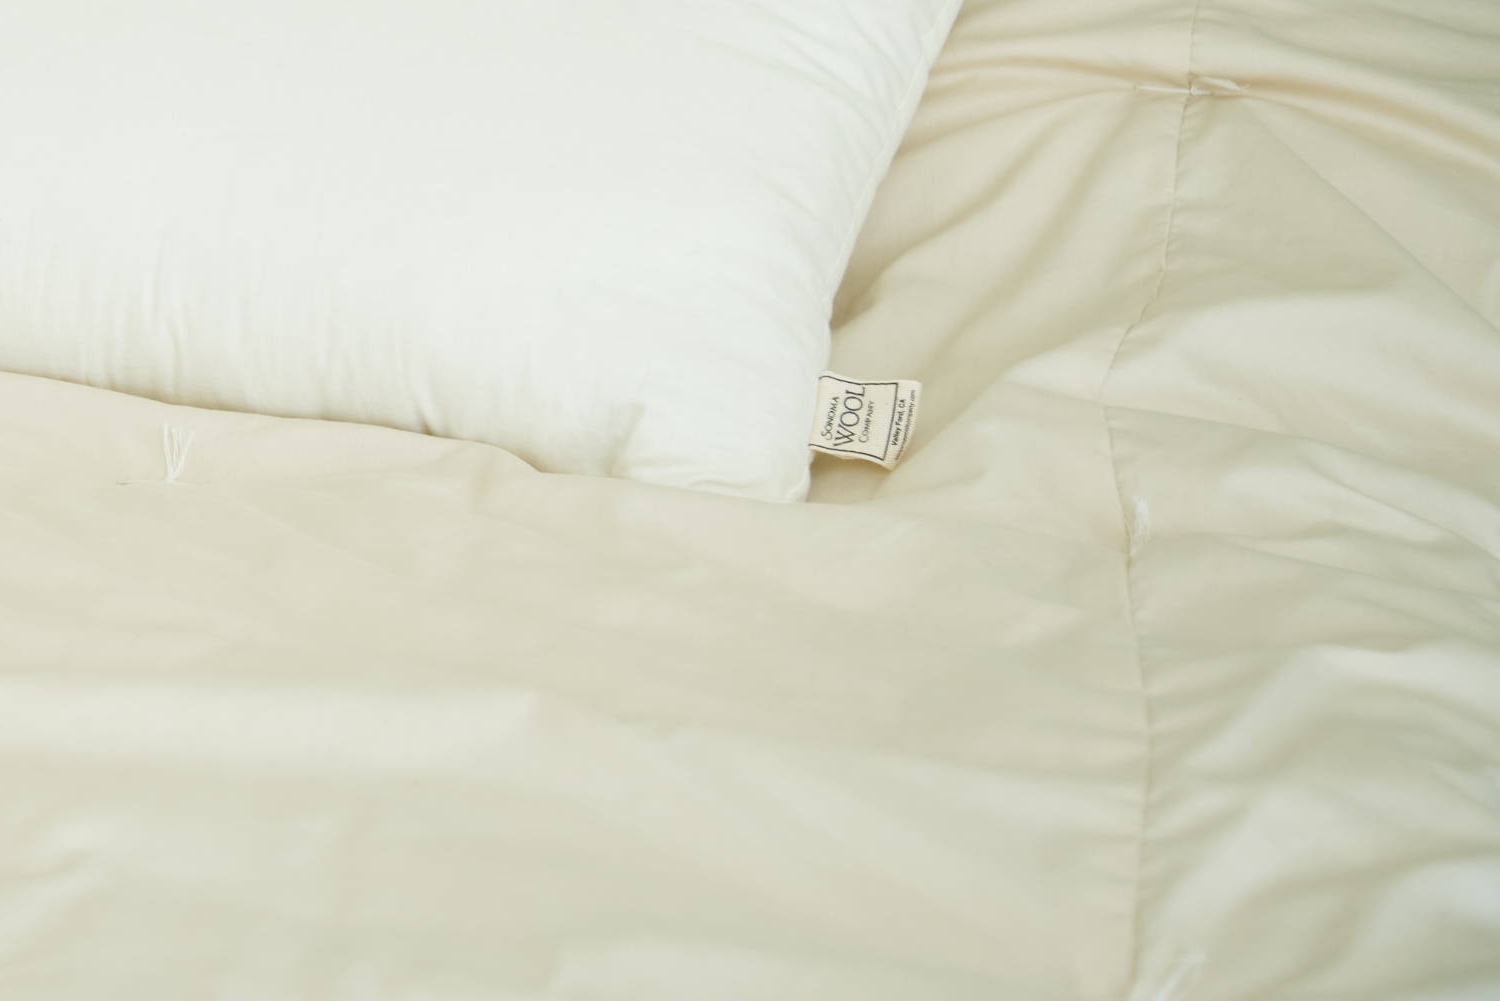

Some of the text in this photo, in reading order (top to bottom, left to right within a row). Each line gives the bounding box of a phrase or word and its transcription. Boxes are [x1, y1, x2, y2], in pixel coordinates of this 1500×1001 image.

[833, 386, 865, 446] WOOL
[891, 427, 901, 446] Valley
[899, 399, 906, 408] CA
